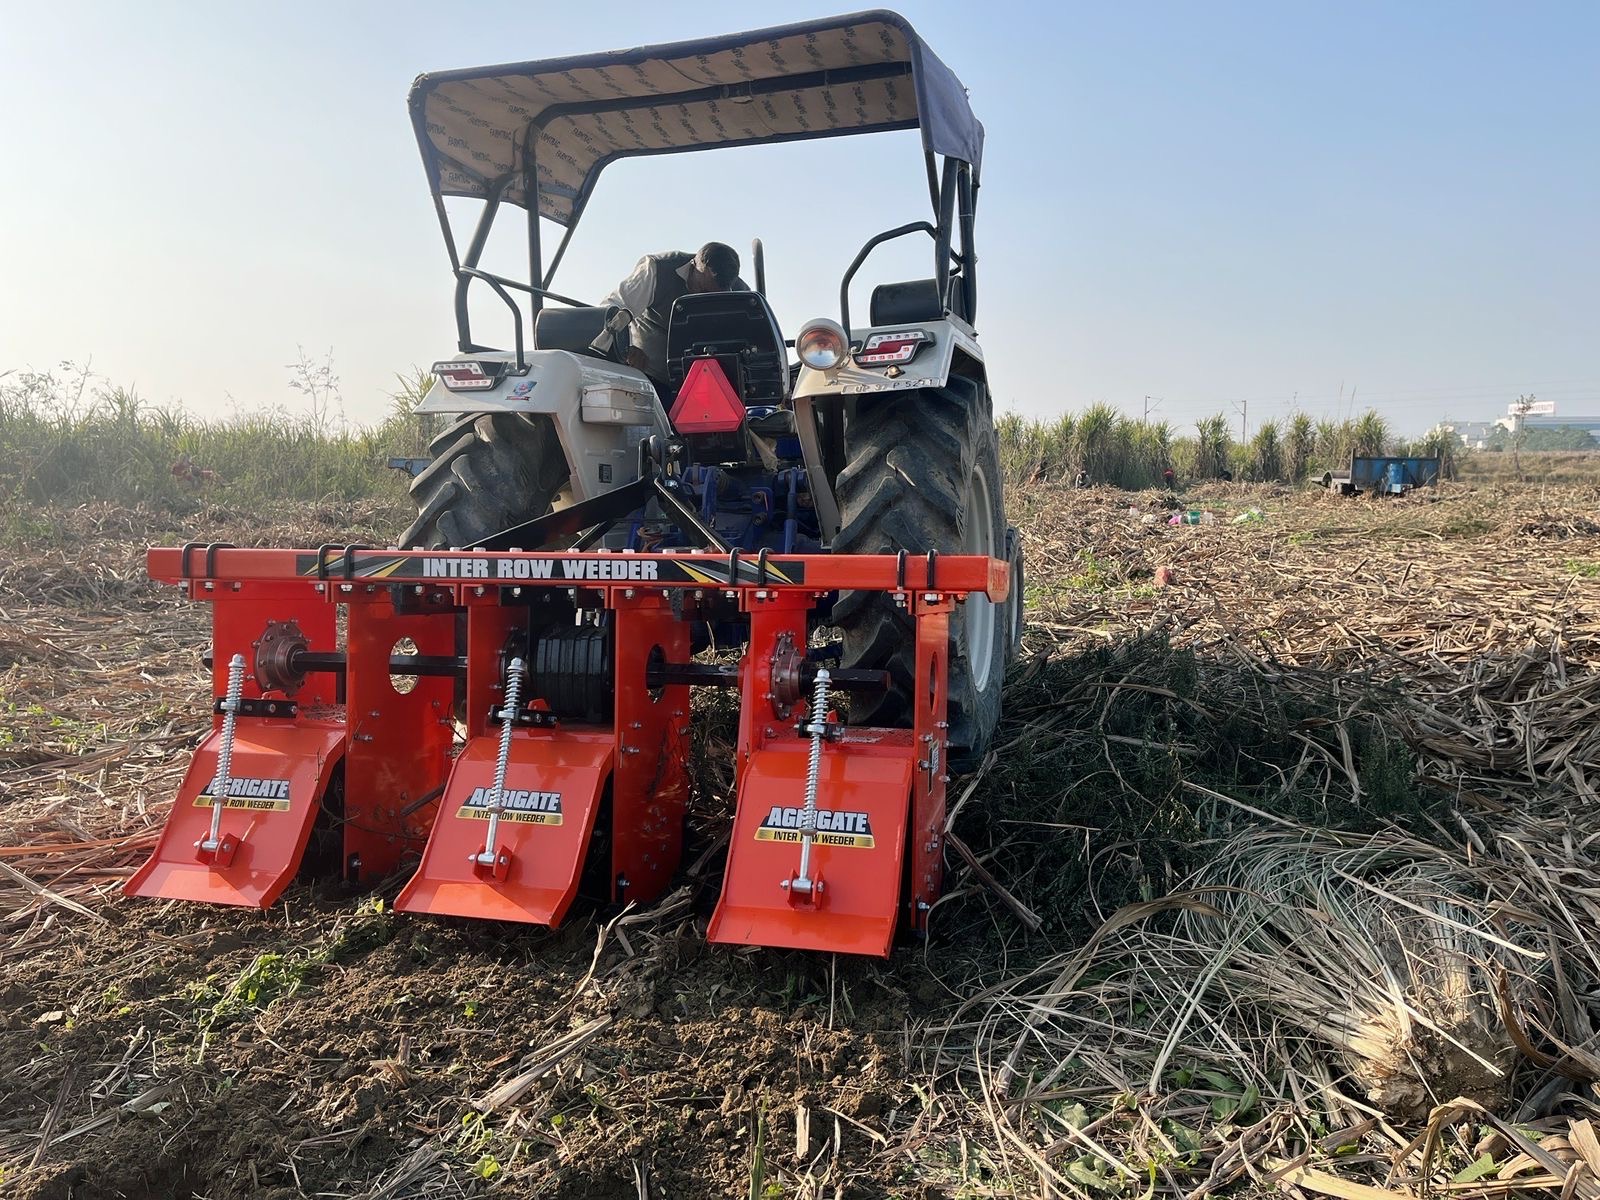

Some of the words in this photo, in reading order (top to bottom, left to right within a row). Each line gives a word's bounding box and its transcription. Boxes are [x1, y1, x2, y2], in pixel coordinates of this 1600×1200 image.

[423, 558, 489, 577] INTER
[497, 559, 553, 579] ROW
[562, 560, 658, 580] WEEDER
[229, 799, 246, 808] ROW
[247, 800, 275, 809] WEEDER
[473, 810, 496, 820] INTE
[498, 811, 515, 821] OW
[516, 812, 546, 823] WEEDER
[774, 831, 798, 841] INTER
[821, 834, 855, 846] WEEDER
